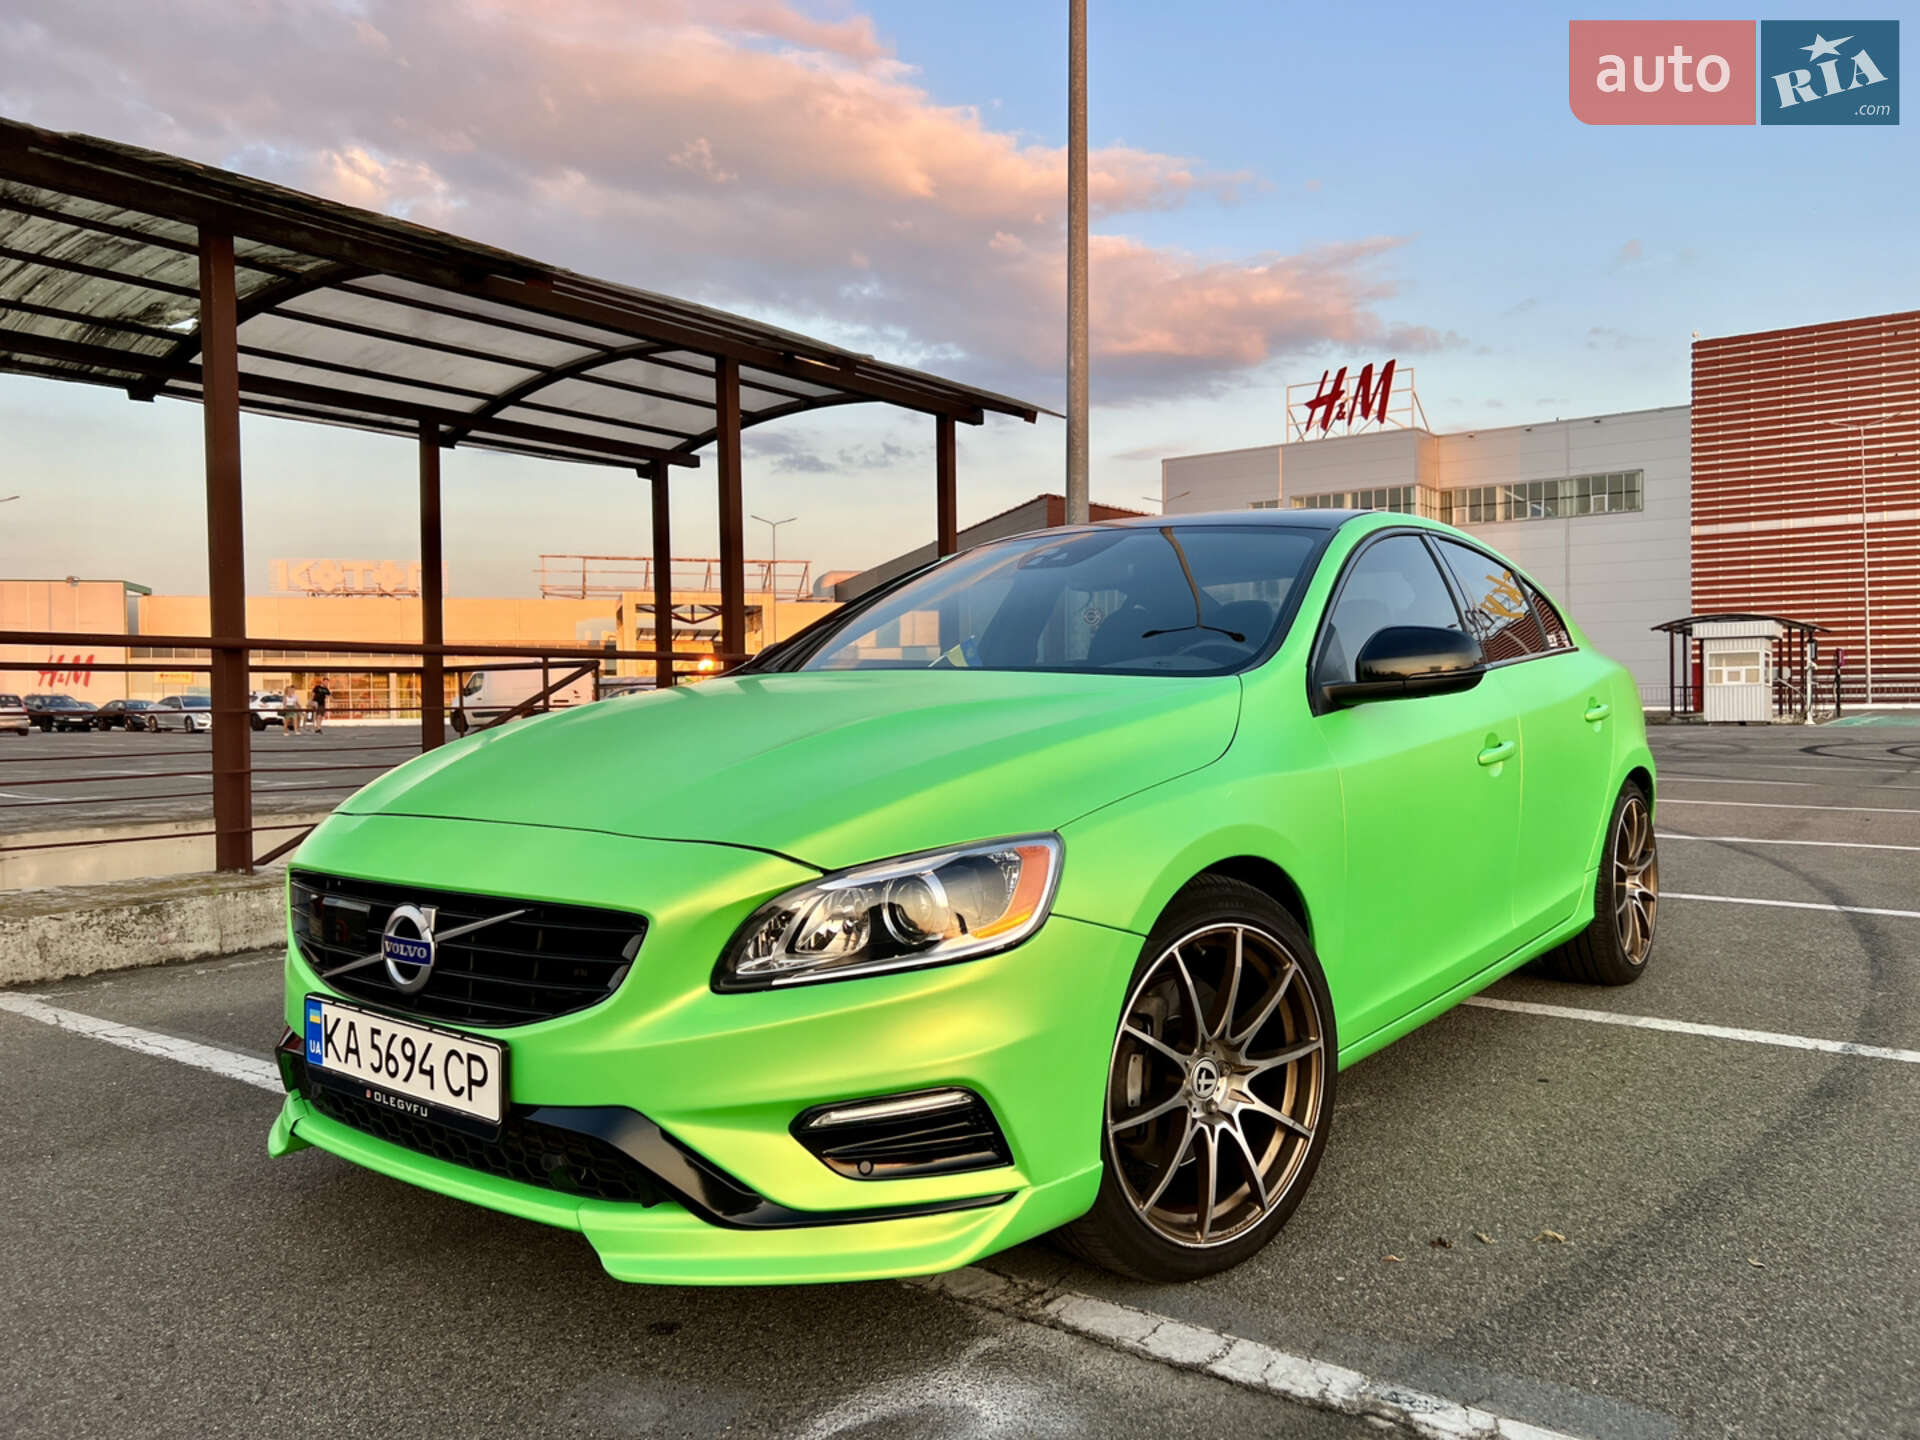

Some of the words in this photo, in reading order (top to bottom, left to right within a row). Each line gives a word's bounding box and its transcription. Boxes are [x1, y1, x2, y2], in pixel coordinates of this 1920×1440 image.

[1304, 358, 1396, 433] H&M
[38, 654, 95, 687] H&M
[384, 940, 428, 959] VOLVO
[309, 1039, 322, 1055] UA
[323, 1014, 362, 1068] KA
[370, 1027, 435, 1090] 5694
[444, 1049, 489, 1102] CP
